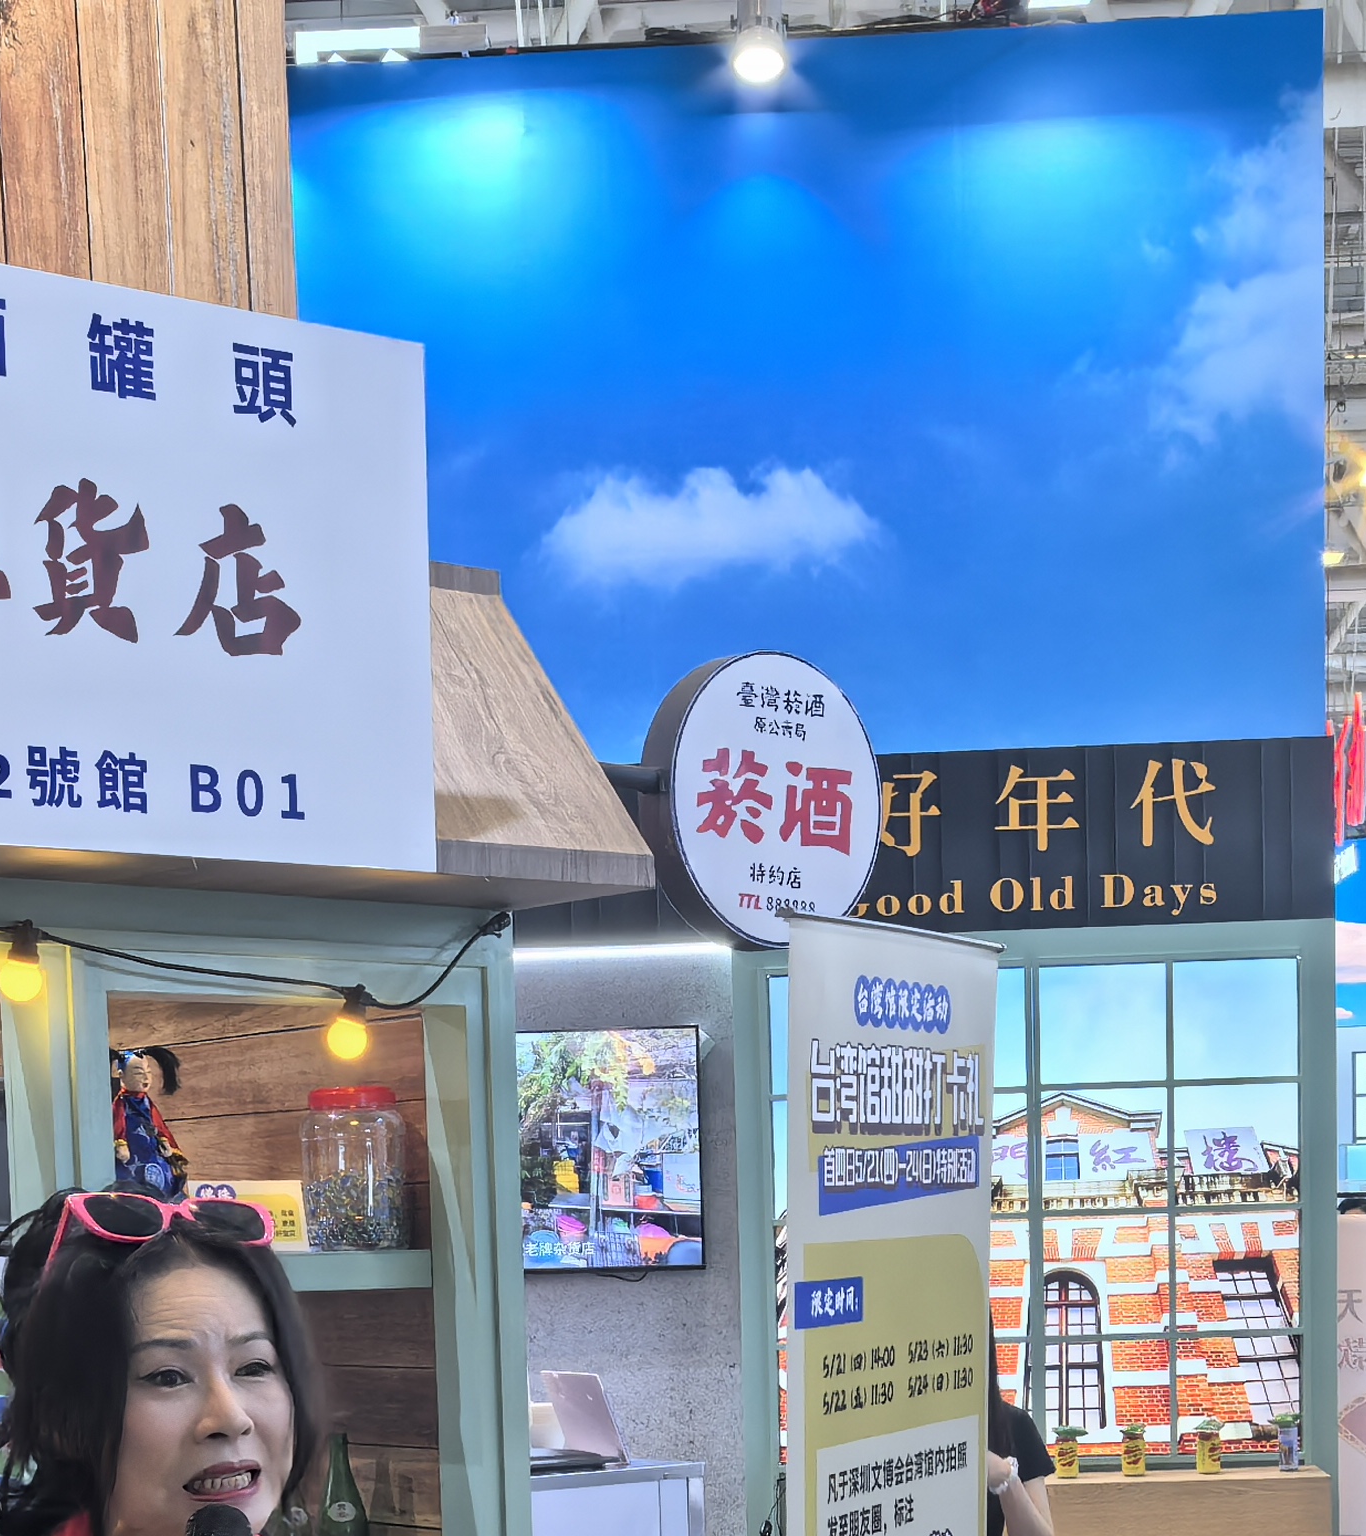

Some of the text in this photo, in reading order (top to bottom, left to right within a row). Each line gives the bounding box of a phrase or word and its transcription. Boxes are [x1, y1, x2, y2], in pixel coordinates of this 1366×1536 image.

[737, 682, 825, 718] 臺灣菸酒
[192, 764, 305, 821] B01
[696, 748, 853, 856] 菸酒
[881, 759, 1215, 857] 好年代
[989, 875, 1075, 913] Old
[1100, 873, 1218, 919] Days
[858, 981, 948, 1022] 台湾馆限定活动
[810, 1039, 984, 1128] 台湾馆甜甜打卡礼
[522, 1241, 595, 1257] 老牌杂货店
[827, 1441, 967, 1504] 凡于深圳文博会台湾馆内拍照
